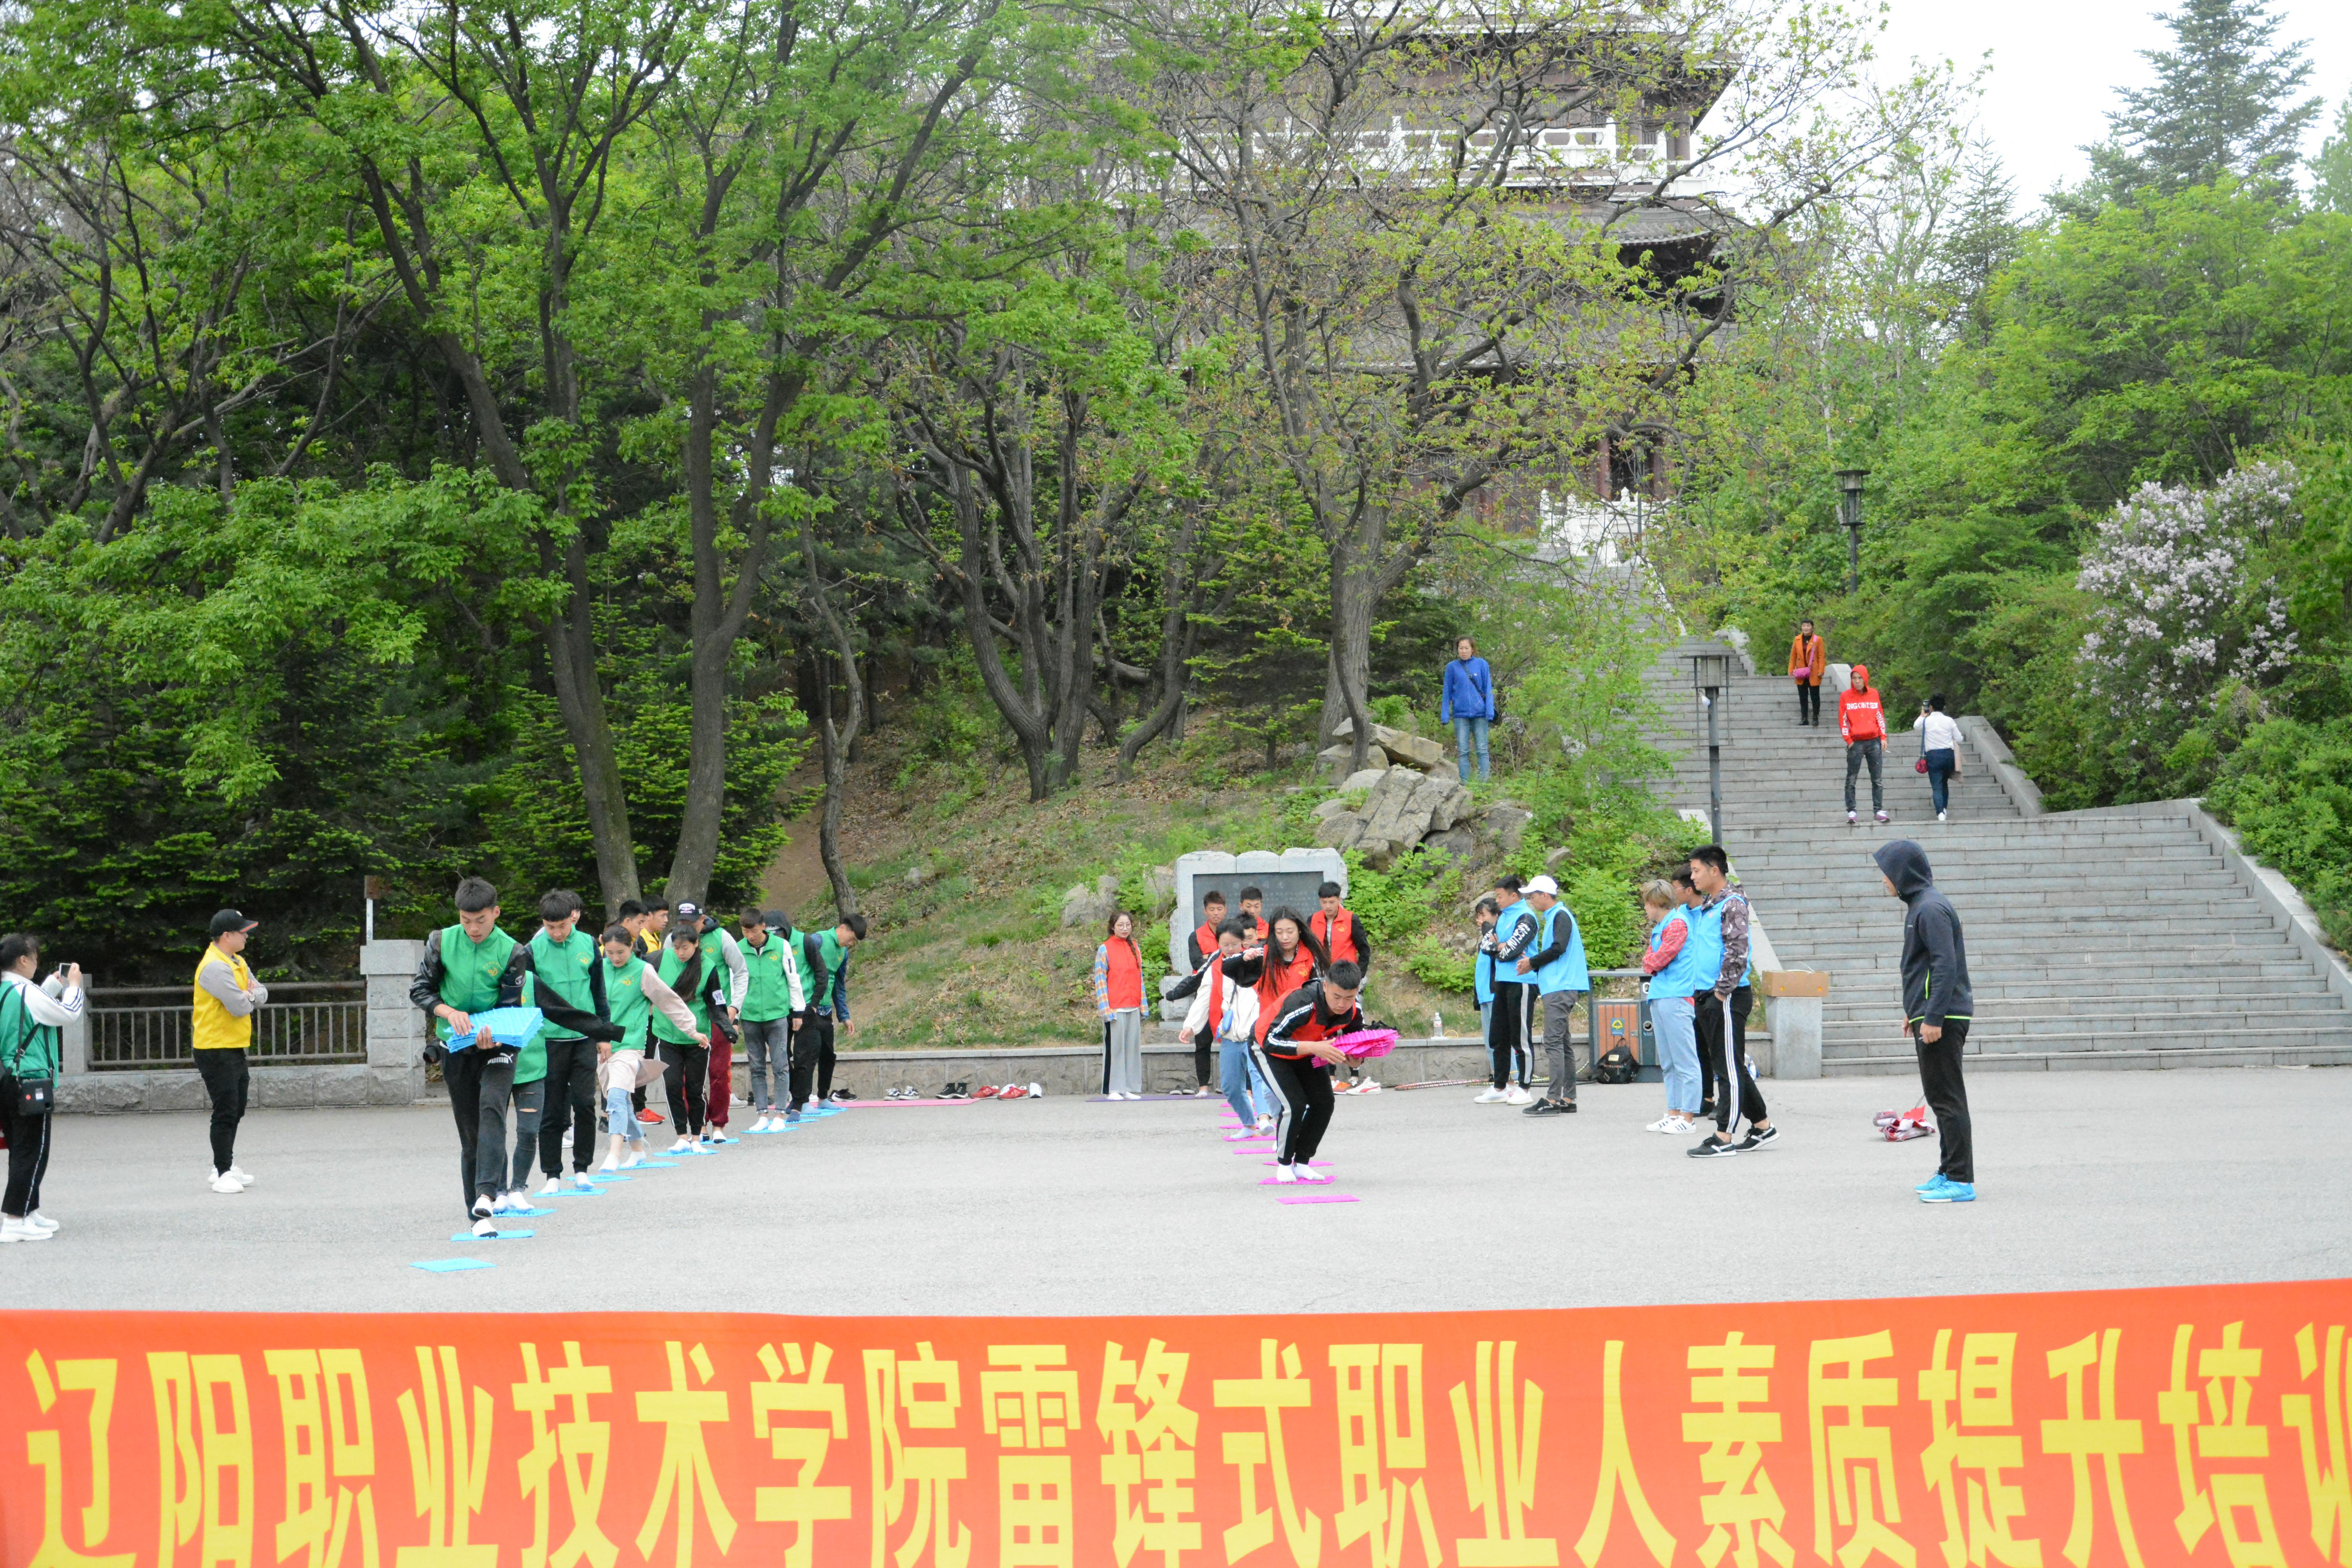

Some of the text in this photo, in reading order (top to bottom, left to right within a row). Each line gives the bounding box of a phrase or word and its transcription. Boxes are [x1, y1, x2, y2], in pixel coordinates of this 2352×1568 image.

[25, 1320, 2352, 1568] 辽阳职业技术学院雷锋式职业人素质提升培训
